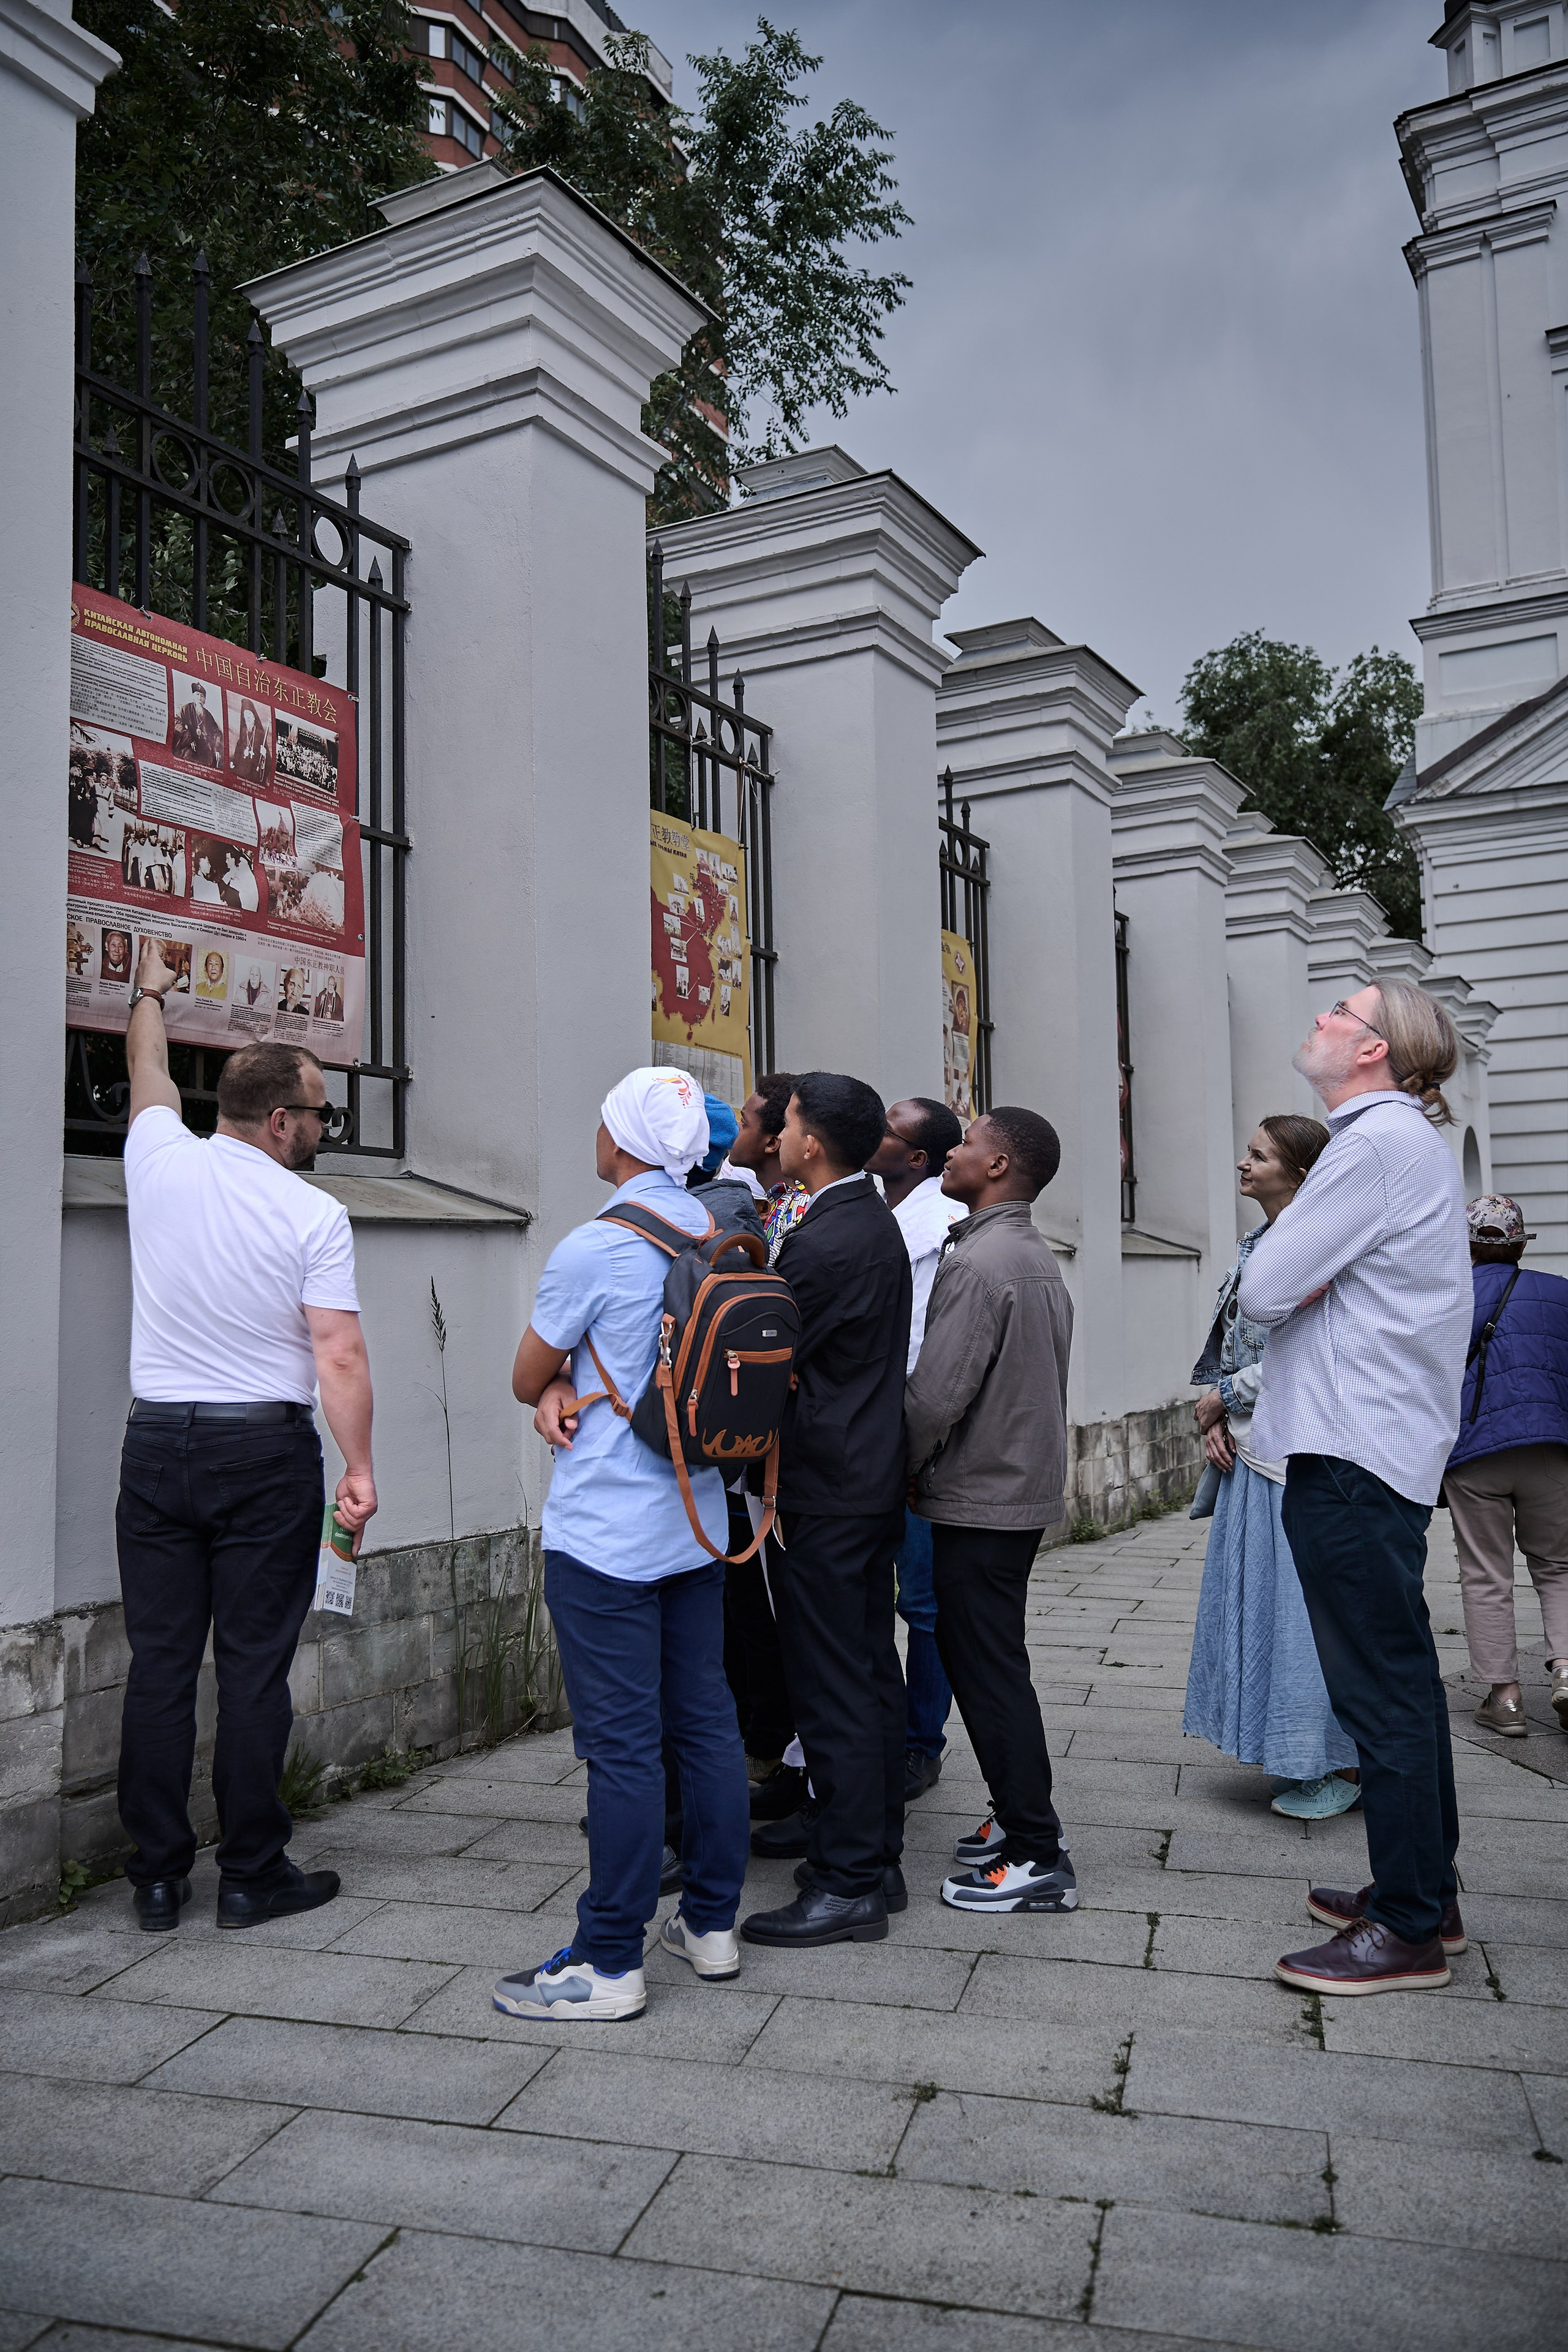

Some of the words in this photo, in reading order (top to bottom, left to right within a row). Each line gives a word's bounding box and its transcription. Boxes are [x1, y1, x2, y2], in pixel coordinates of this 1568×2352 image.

[84, 608, 134, 633] КИТАЙСКАЯ
[136, 628, 187, 654] АВТОНОМНАЯ
[84, 619, 149, 648] ПРАВОСЛАВНАЯ
[151, 643, 188, 663] ЦЕРКОВЬ
[195, 647, 337, 724] 中国自治东正教会
[673, 849, 687, 859] КИТАЯ
[67, 913, 83, 922] СКОЕ
[86, 917, 131, 931] ПРАВОСЛАВНОЕ
[134, 926, 172, 938] ДУХОВЕНСТВО
[295, 956, 345, 975] 中国东正教神职人员
